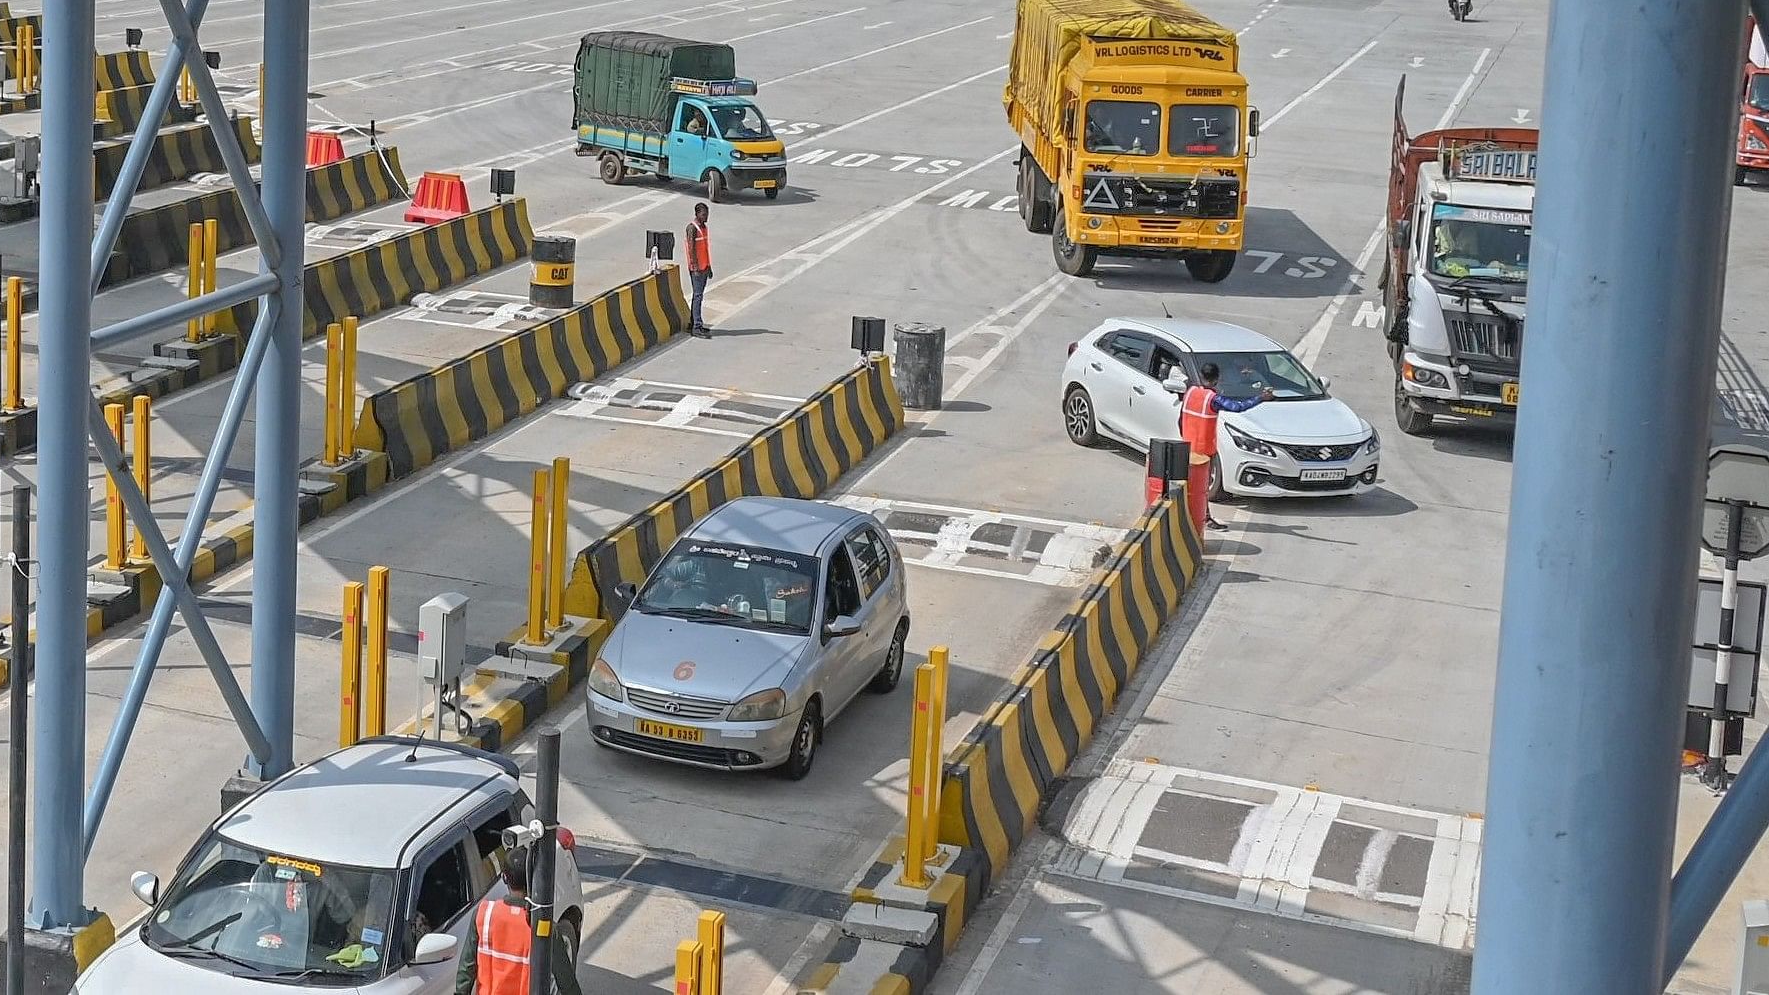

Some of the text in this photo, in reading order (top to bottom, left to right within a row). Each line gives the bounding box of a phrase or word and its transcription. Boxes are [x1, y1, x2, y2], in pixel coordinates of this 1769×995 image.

[1094, 45, 1192, 58] VRL LOGISTICS LTD
[1111, 85, 1223, 97] GOODS CARRIER
[1244, 249, 1338, 279] SL
[551, 267, 569, 280] CAT
